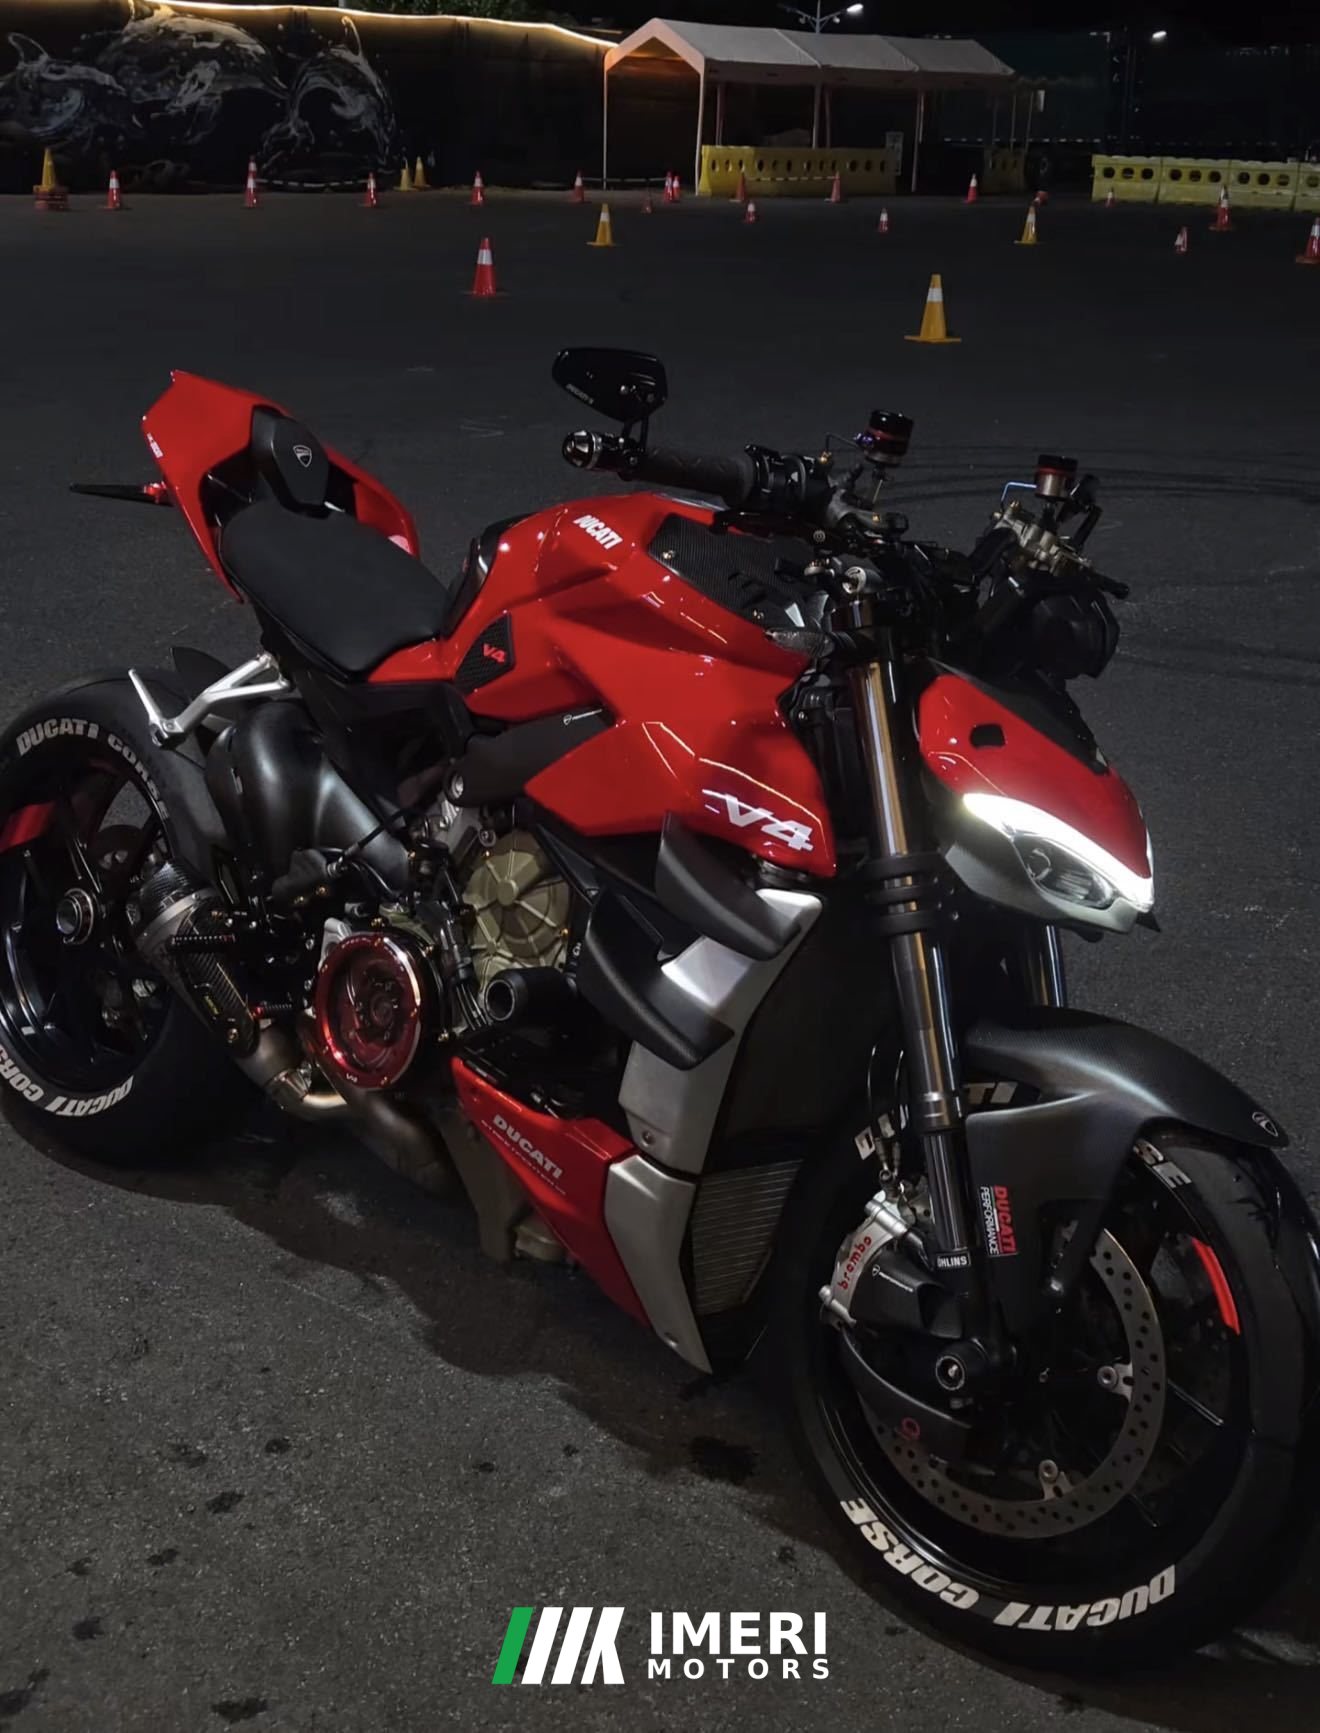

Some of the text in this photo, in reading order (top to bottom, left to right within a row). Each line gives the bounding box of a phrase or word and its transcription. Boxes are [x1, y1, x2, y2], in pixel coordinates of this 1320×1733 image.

[483, 643, 506, 663] V4
[16, 717, 100, 757] DUCATI
[725, 793, 814, 852] V4
[44, 1074, 134, 1117] DUCATI
[493, 1114, 563, 1179] DUCATI
[980, 1186, 1000, 1256] PERFORMANCE
[994, 1185, 1017, 1253] DUCATI
[838, 1236, 872, 1290] brembo
[840, 1497, 1176, 1632] DUCATI CORSE
